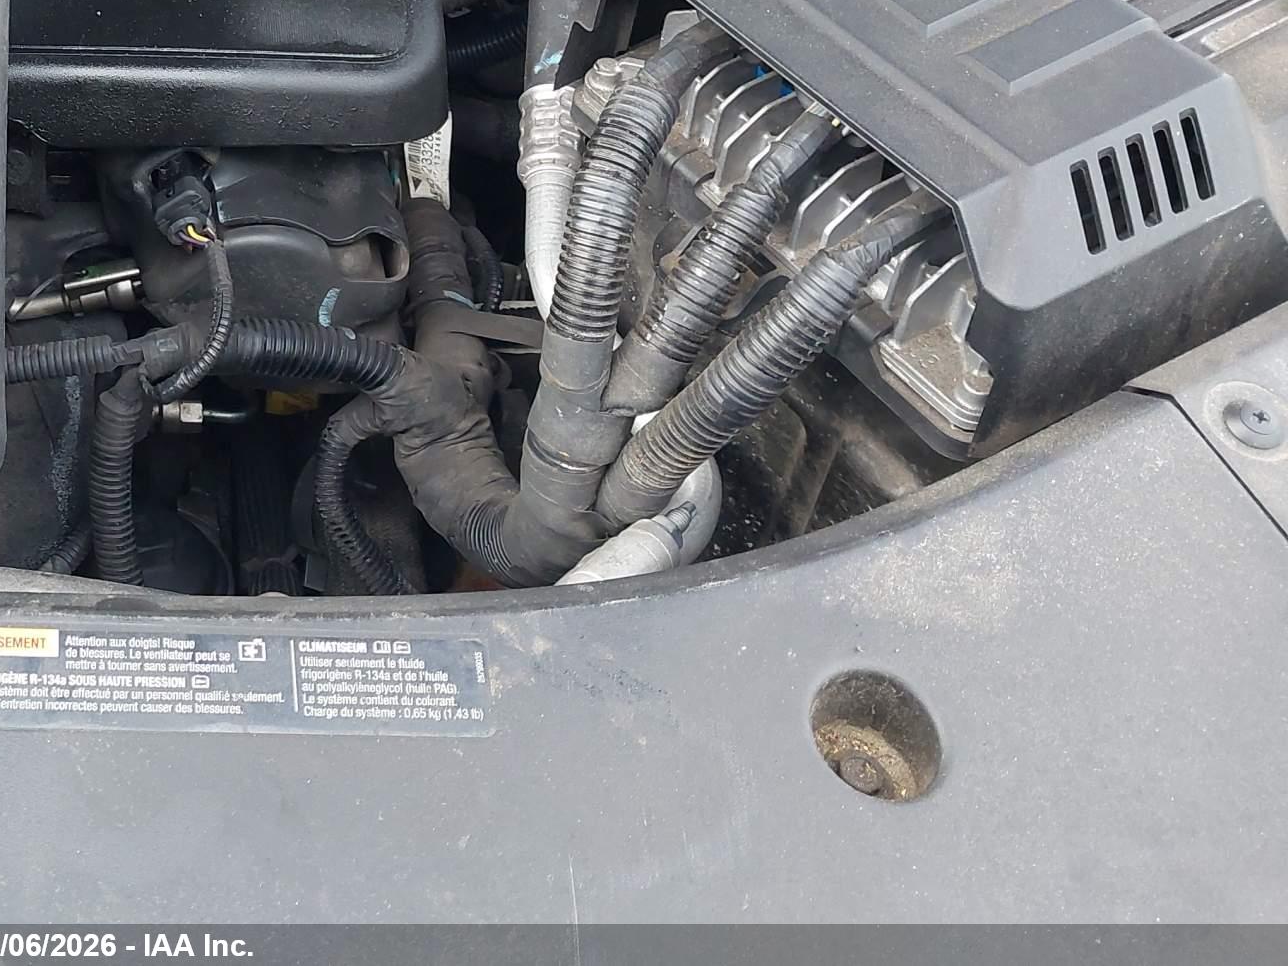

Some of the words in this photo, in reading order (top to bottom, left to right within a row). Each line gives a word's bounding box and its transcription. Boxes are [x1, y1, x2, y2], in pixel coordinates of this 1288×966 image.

[65, 635, 107, 647] Attention
[109, 637, 127, 647] aux
[129, 637, 161, 649] doigts!
[162, 638, 195, 650] Risque
[298, 641, 367, 653] CLIMATISEUR
[65, 647, 77, 658] de
[79, 648, 127, 659] blessures.
[129, 648, 141, 659] Le
[143, 649, 193, 660] ventilateur
[195, 651, 217, 662] peut
[219, 652, 230, 661] se
[65, 659, 97, 670] mettre
[108, 660, 142, 671] tourner
[143, 662, 166, 672] sans
[168, 662, 238, 673] avertissement.
[300, 656, 333, 667] Utiliser
[335, 657, 385, 668] seulement
[387, 658, 396, 668] le
[398, 658, 425, 669] fluide
[29, 673, 67, 685] R-134a
[68, 675, 97, 686] SOUS
[98, 676, 133, 687] HAUTE
[134, 676, 186, 688] PRESSION
[300, 668, 352, 681] frigorigène
[354, 669, 390, 681] R-134a
[393, 670, 403, 681] et
[404, 670, 417, 681] de
[419, 670, 449, 682] l'huile
[31, 686, 49, 697] doit
[50, 687, 70, 698] être
[72, 687, 111, 699] effectué
[113, 690, 128, 701] par
[131, 690, 144, 700] un
[146, 690, 193, 702] personnel
[194, 690, 230, 702] qualifié
[301, 683, 314, 692] au
[316, 682, 403, 694] polyalkylèneglycol
[405, 683, 432, 695] (huile
[45, 699, 98, 712] incorrectes
[100, 702, 139, 714] peuvent
[140, 703, 173, 713] causer
[175, 702, 193, 713] des
[194, 703, 244, 714] blessures.
[303, 693, 315, 704] Le
[316, 694, 358, 706] système
[360, 694, 399, 705] contient
[400, 695, 414, 706] du
[415, 694, 458, 706] colorant.
[304, 705, 338, 719] Charge
[340, 706, 353, 717] du
[355, 707, 396, 719] système
[428, 708, 442, 721] kg
[470, 707, 484, 722] lb)
